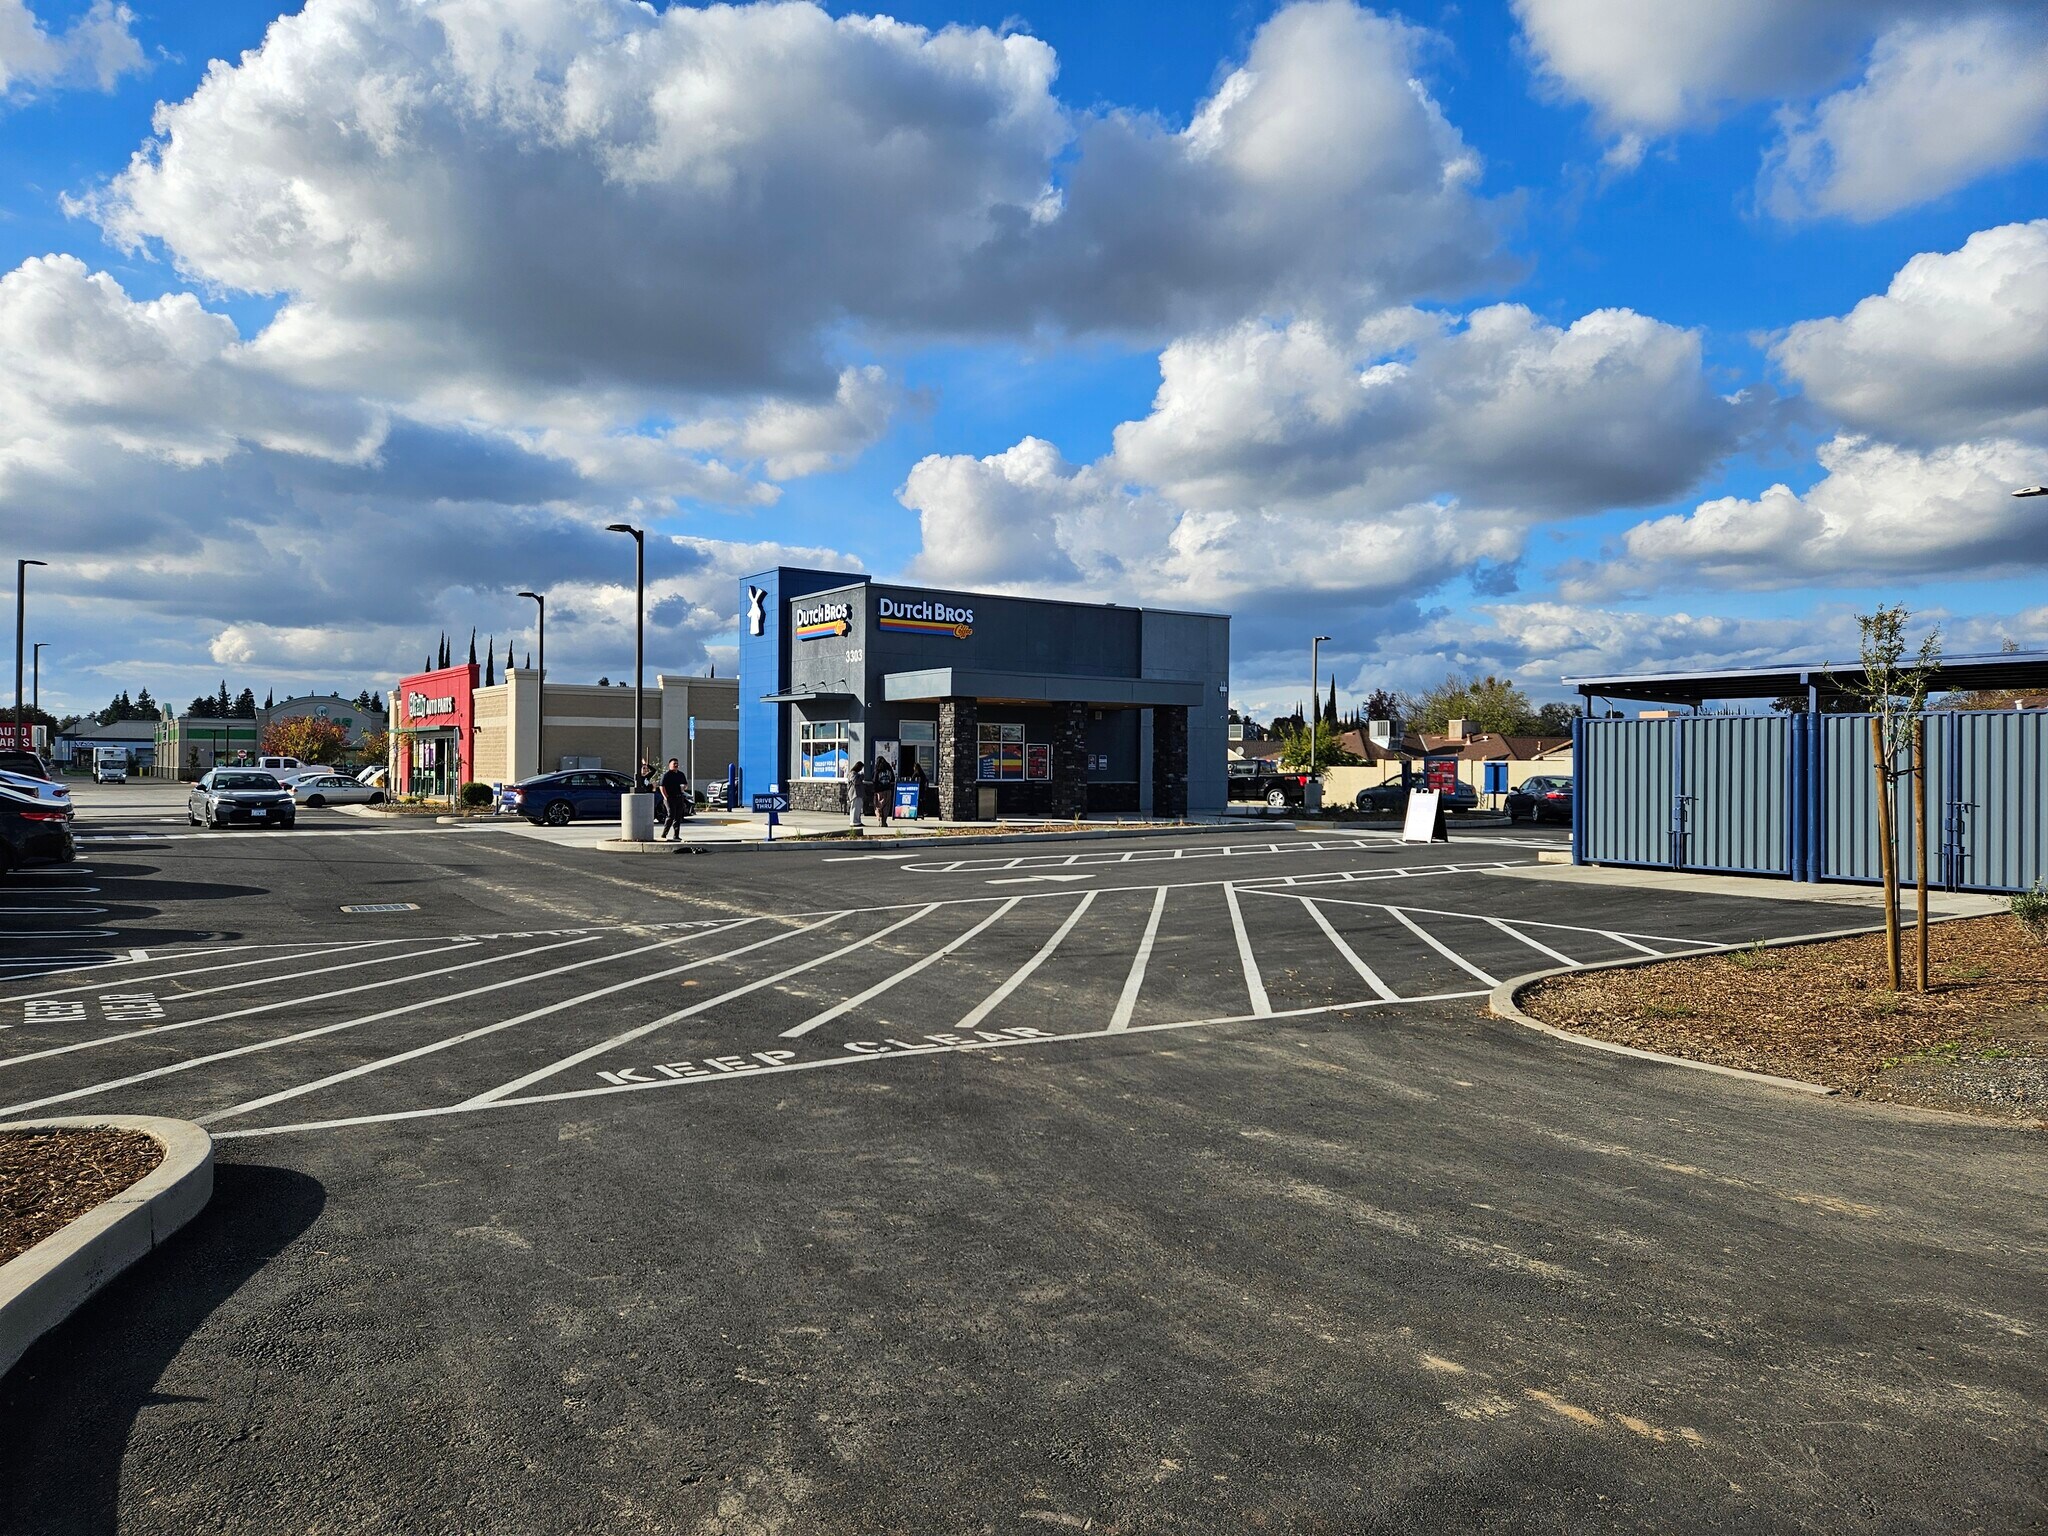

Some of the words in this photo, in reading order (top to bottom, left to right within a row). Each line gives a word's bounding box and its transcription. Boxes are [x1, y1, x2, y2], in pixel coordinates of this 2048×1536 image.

[825, 603, 848, 621] BROS
[935, 602, 974, 624] BROS
[953, 623, 973, 639] Coffee
[845, 649, 863, 663] 3303
[0, 737, 30, 747] ARS
[23, 1001, 87, 1024] KEEP
[98, 993, 166, 1021] CLEAR
[596, 1049, 796, 1085] KEEP
[843, 1026, 1056, 1054] CLEAR
